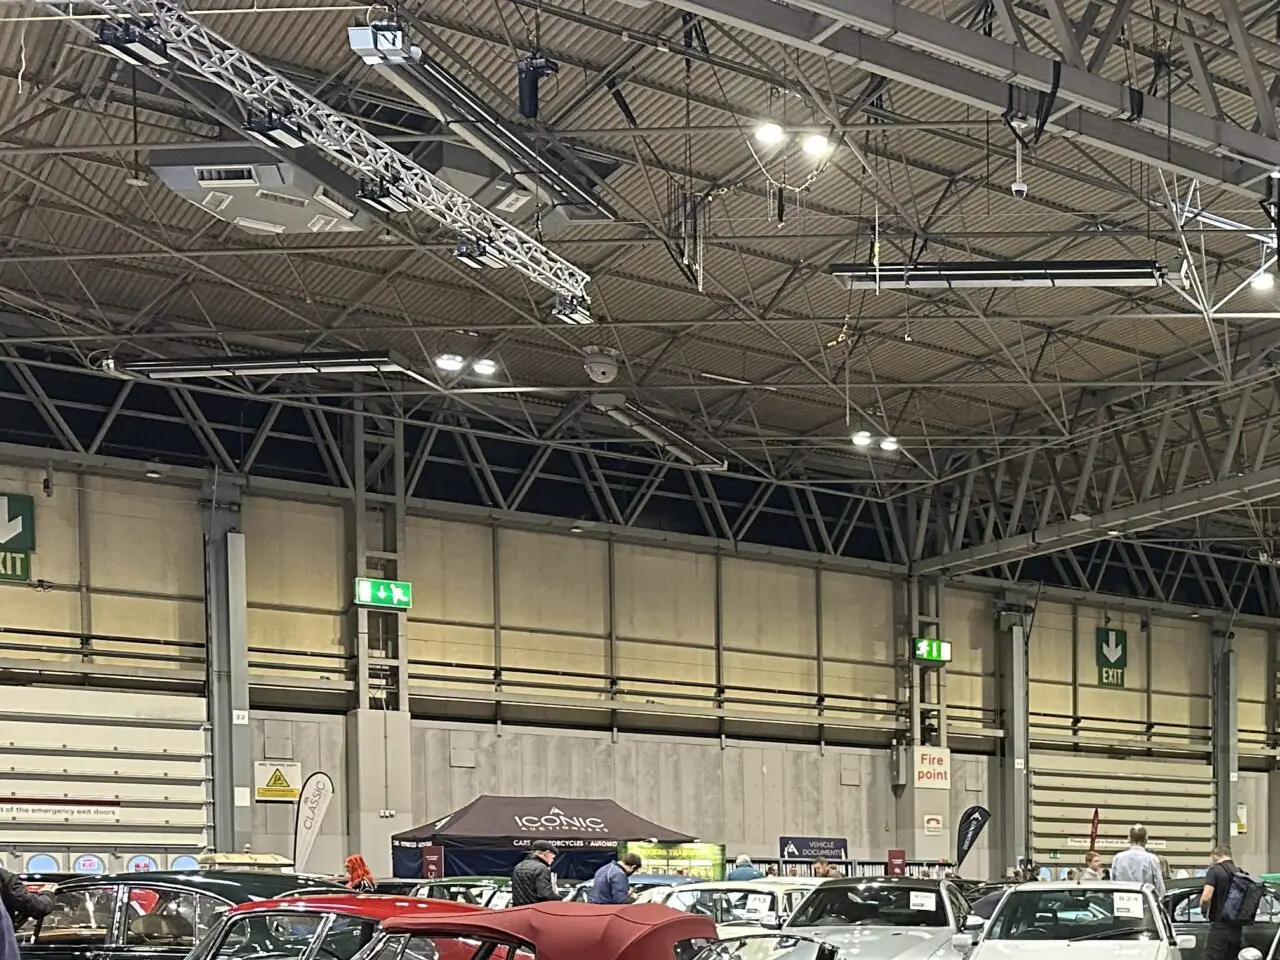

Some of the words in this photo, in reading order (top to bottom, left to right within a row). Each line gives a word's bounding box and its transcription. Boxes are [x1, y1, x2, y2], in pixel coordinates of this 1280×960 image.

[0, 551, 25, 576] XIT
[1102, 667, 1123, 684] EXIT
[920, 753, 944, 766] Fire
[917, 770, 948, 781] point
[303, 780, 326, 830] CLASSIC
[31, 808, 75, 816] emergency
[514, 815, 605, 828] ICONIC
